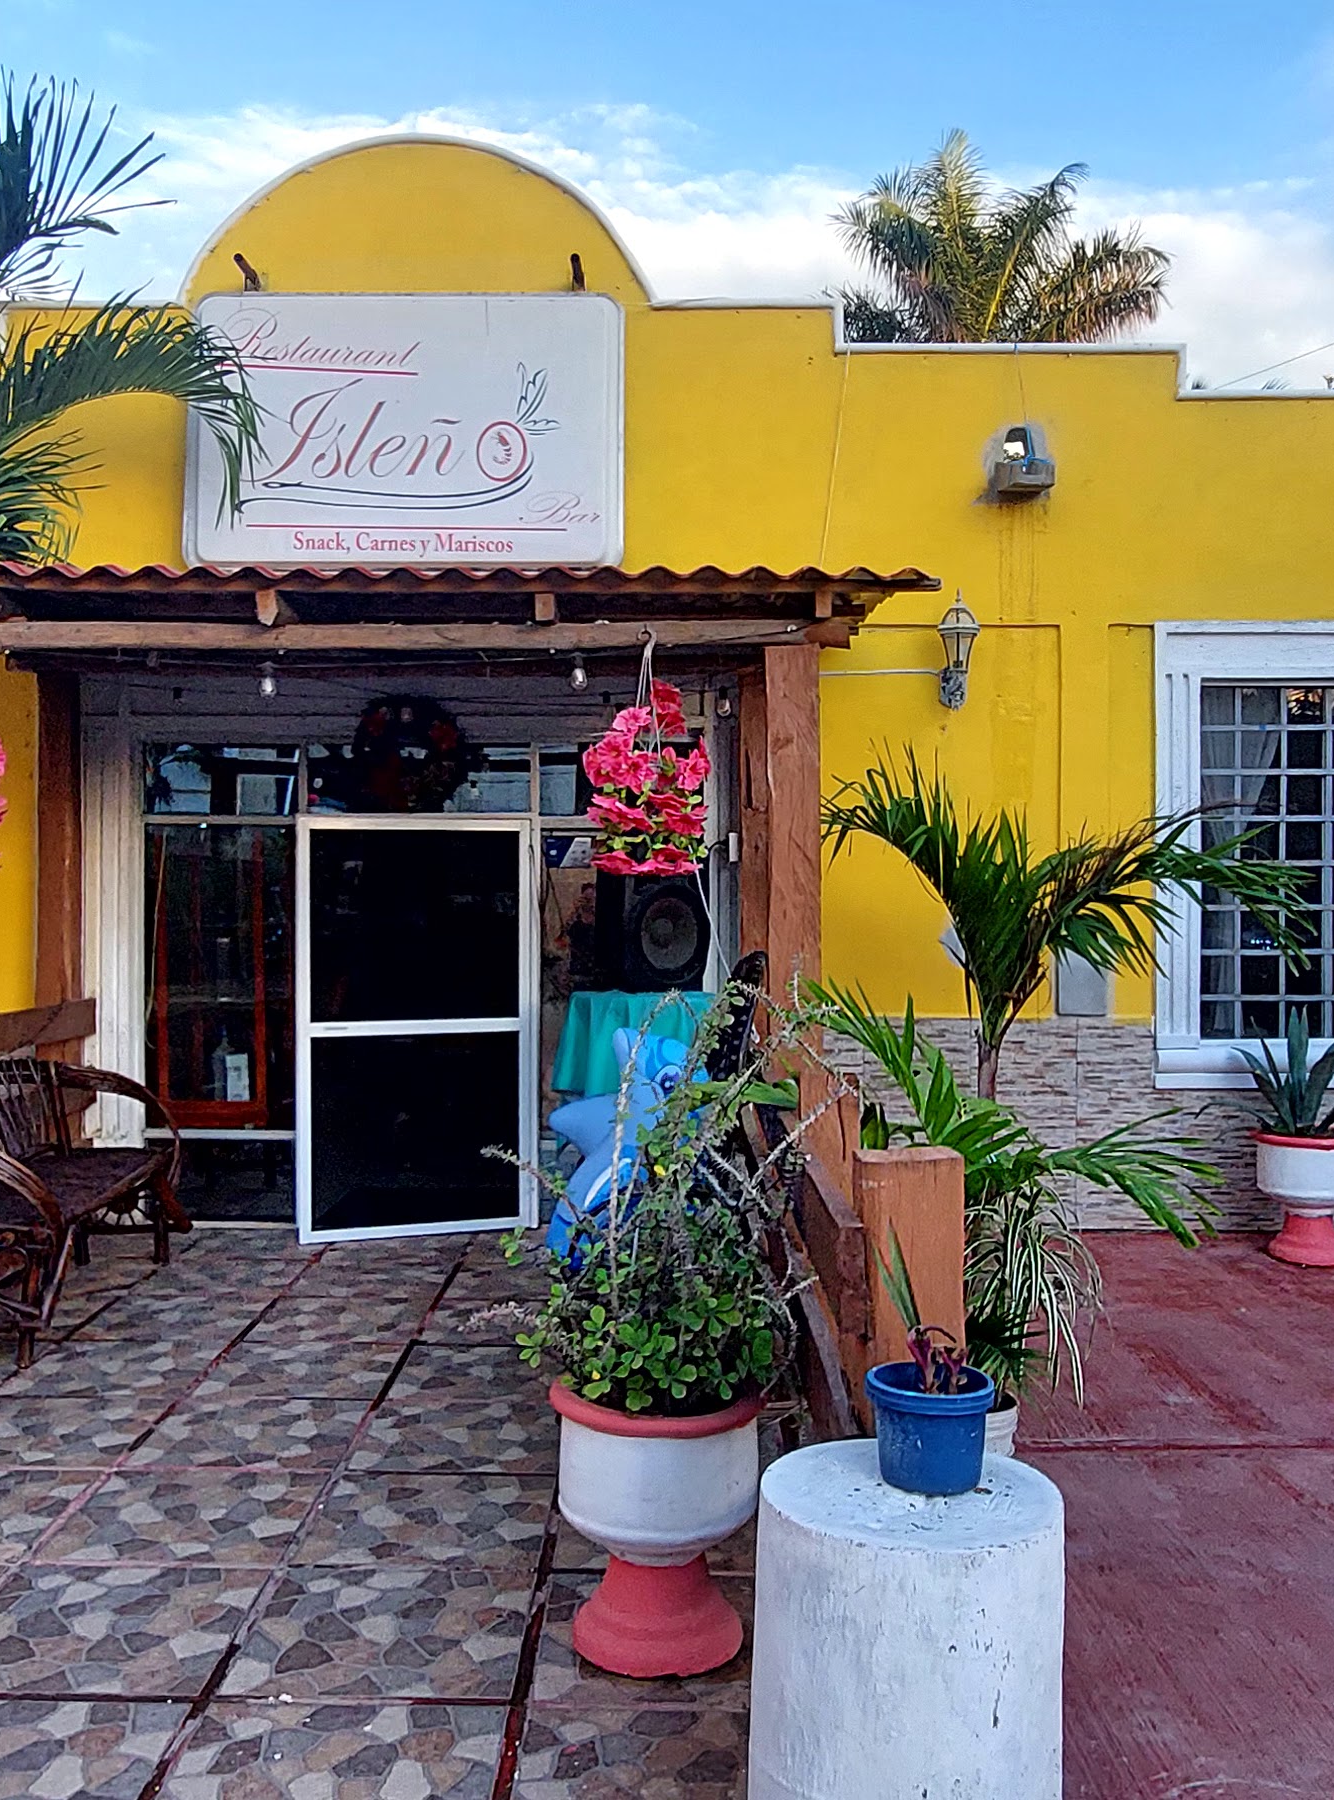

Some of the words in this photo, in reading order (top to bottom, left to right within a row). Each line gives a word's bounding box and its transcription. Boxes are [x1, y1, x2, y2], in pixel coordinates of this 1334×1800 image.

[224, 307, 421, 367] Restaurant
[521, 490, 601, 524] Bar
[293, 531, 351, 555] Snack,
[356, 532, 417, 553] Carnes
[418, 537, 429, 558] y
[434, 533, 514, 554] Mariscos
